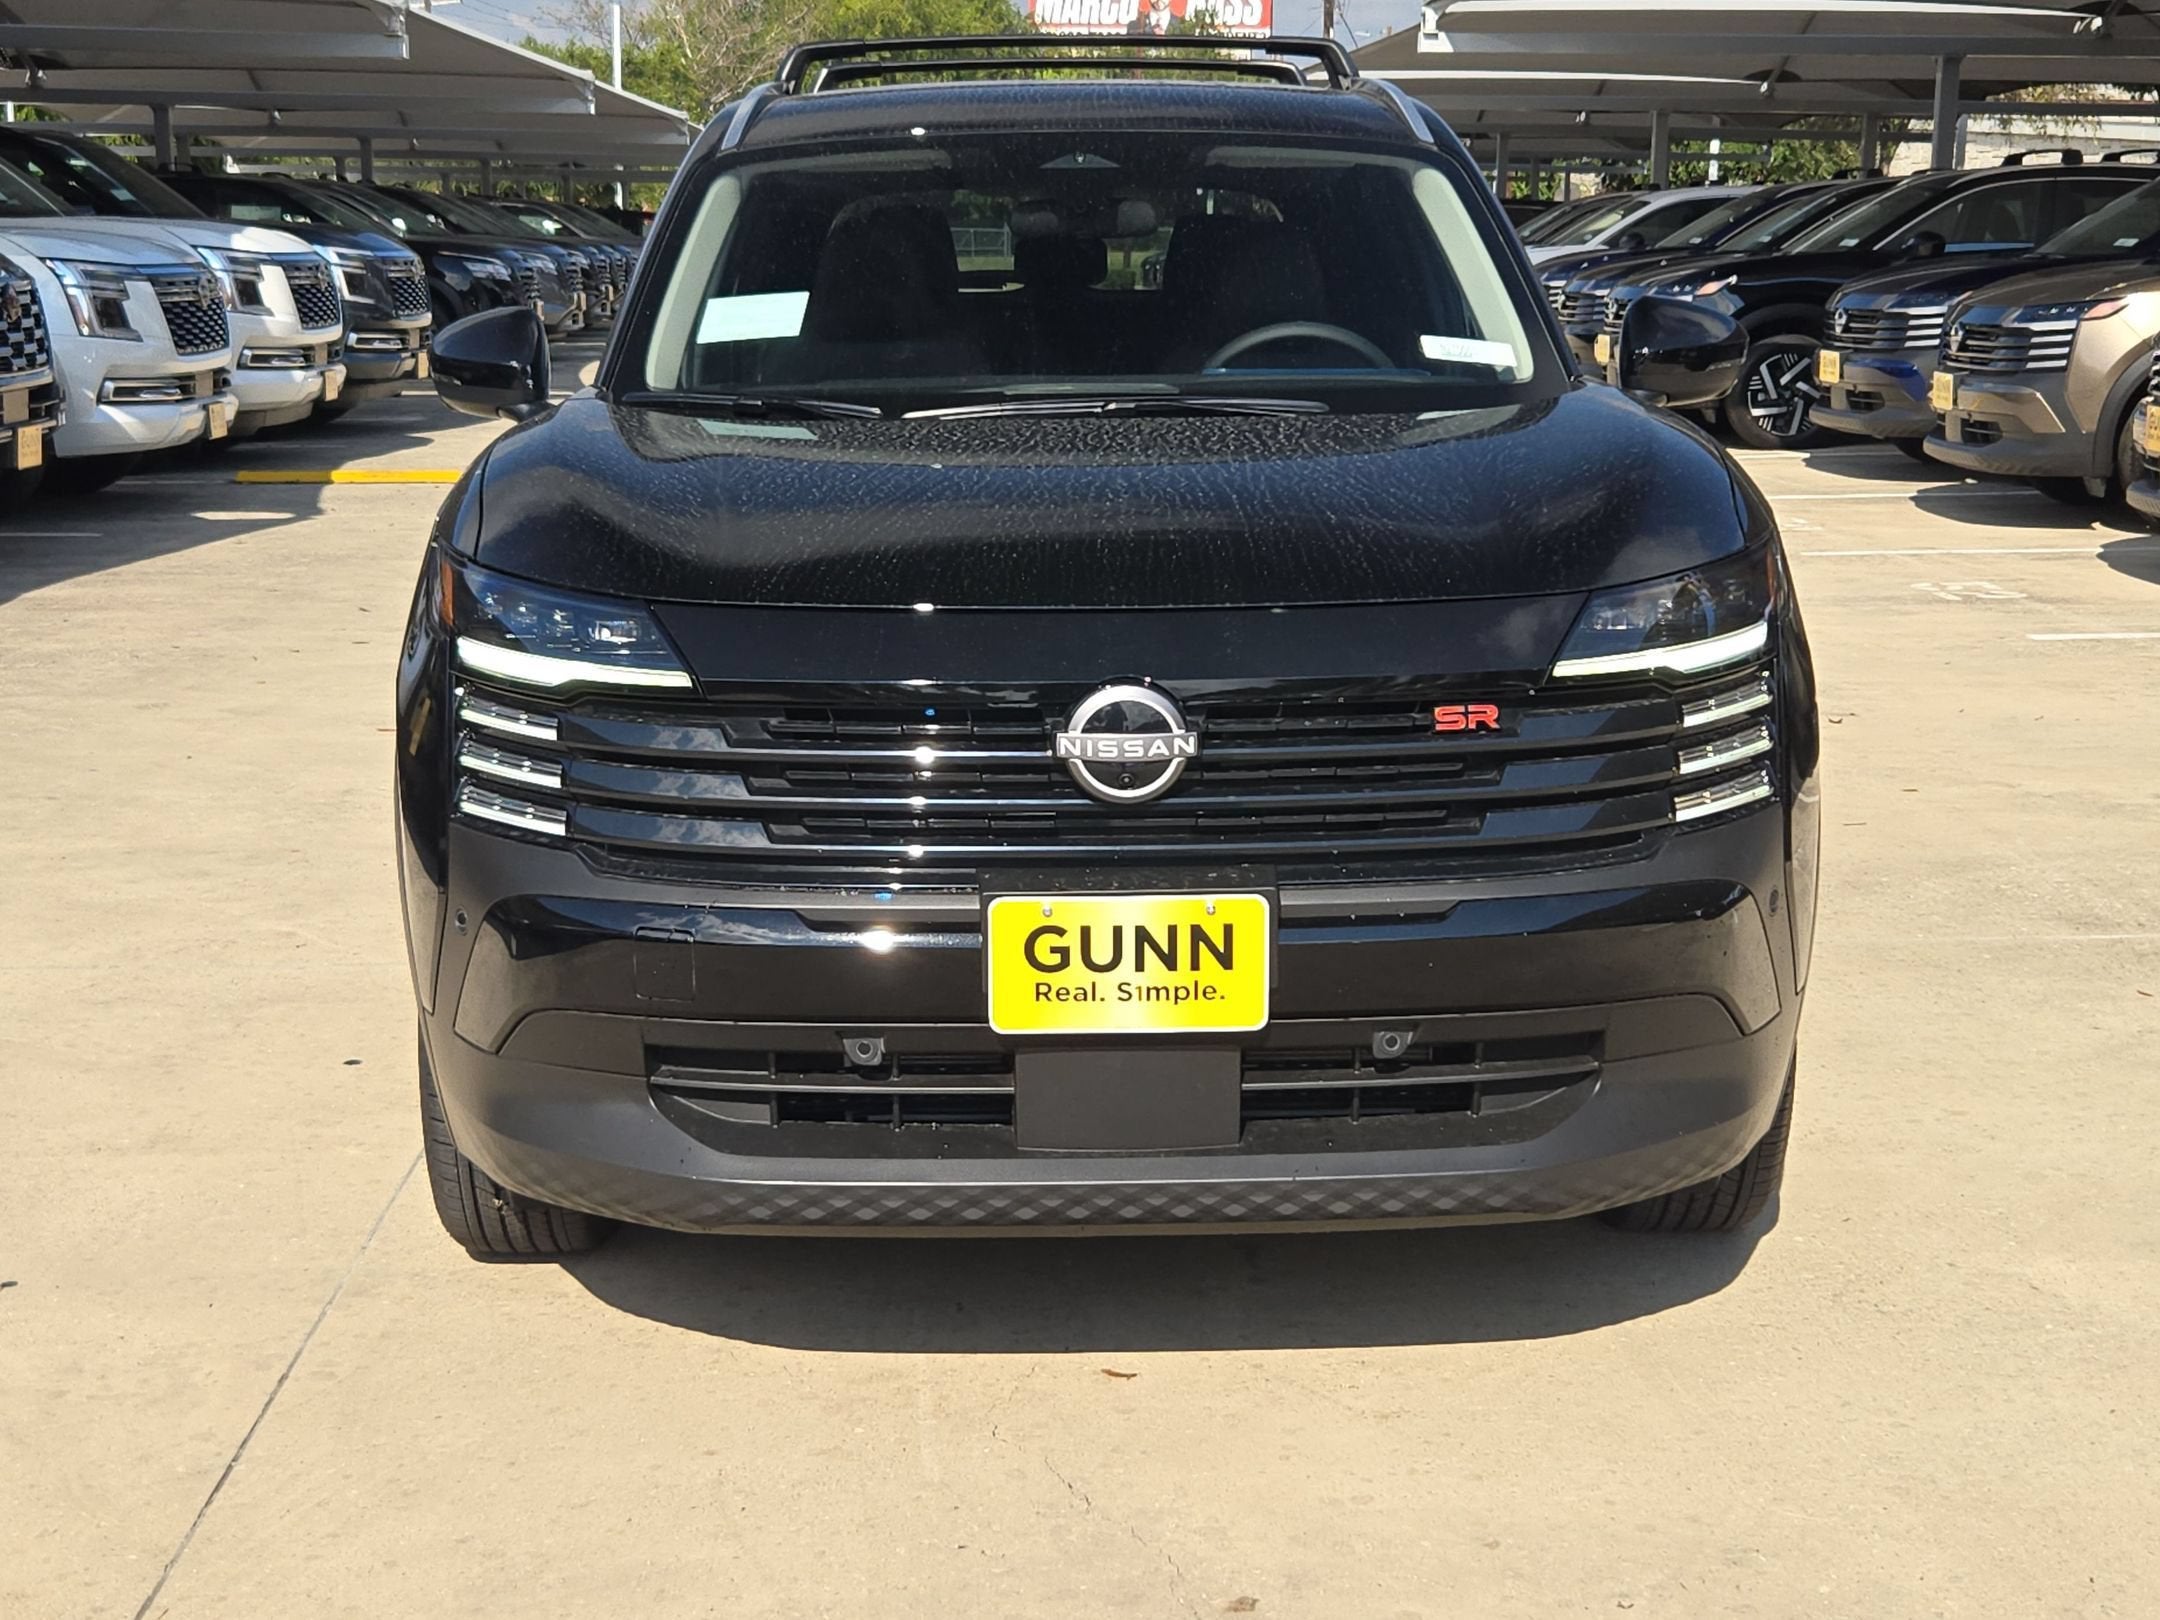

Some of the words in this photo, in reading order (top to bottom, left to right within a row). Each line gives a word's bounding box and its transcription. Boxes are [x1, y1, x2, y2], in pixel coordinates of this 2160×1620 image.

[1434, 704, 1500, 731] SR
[1060, 736, 1195, 758] NISSAN
[1024, 923, 1234, 974] GUNN
[1035, 981, 1105, 1002] Real.
